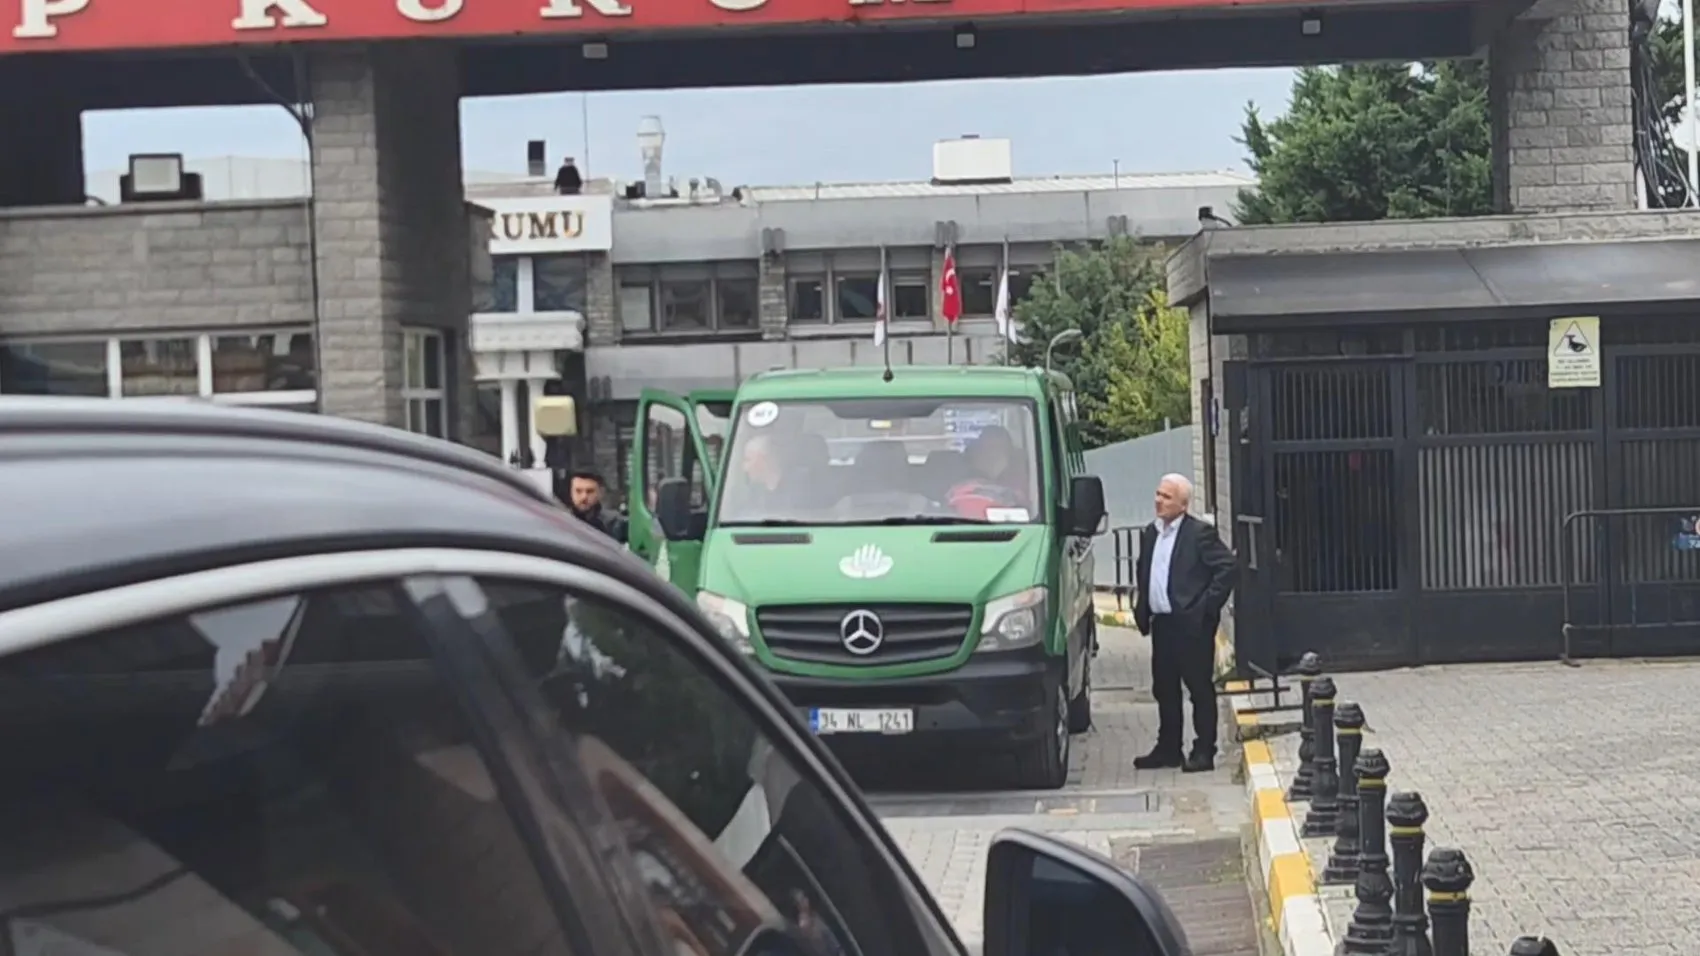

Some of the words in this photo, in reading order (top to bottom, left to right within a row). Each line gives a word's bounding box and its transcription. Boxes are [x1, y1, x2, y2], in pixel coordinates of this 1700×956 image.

[821, 711, 838, 729] 34
[847, 711, 865, 729] NL
[878, 711, 909, 730] 1241
